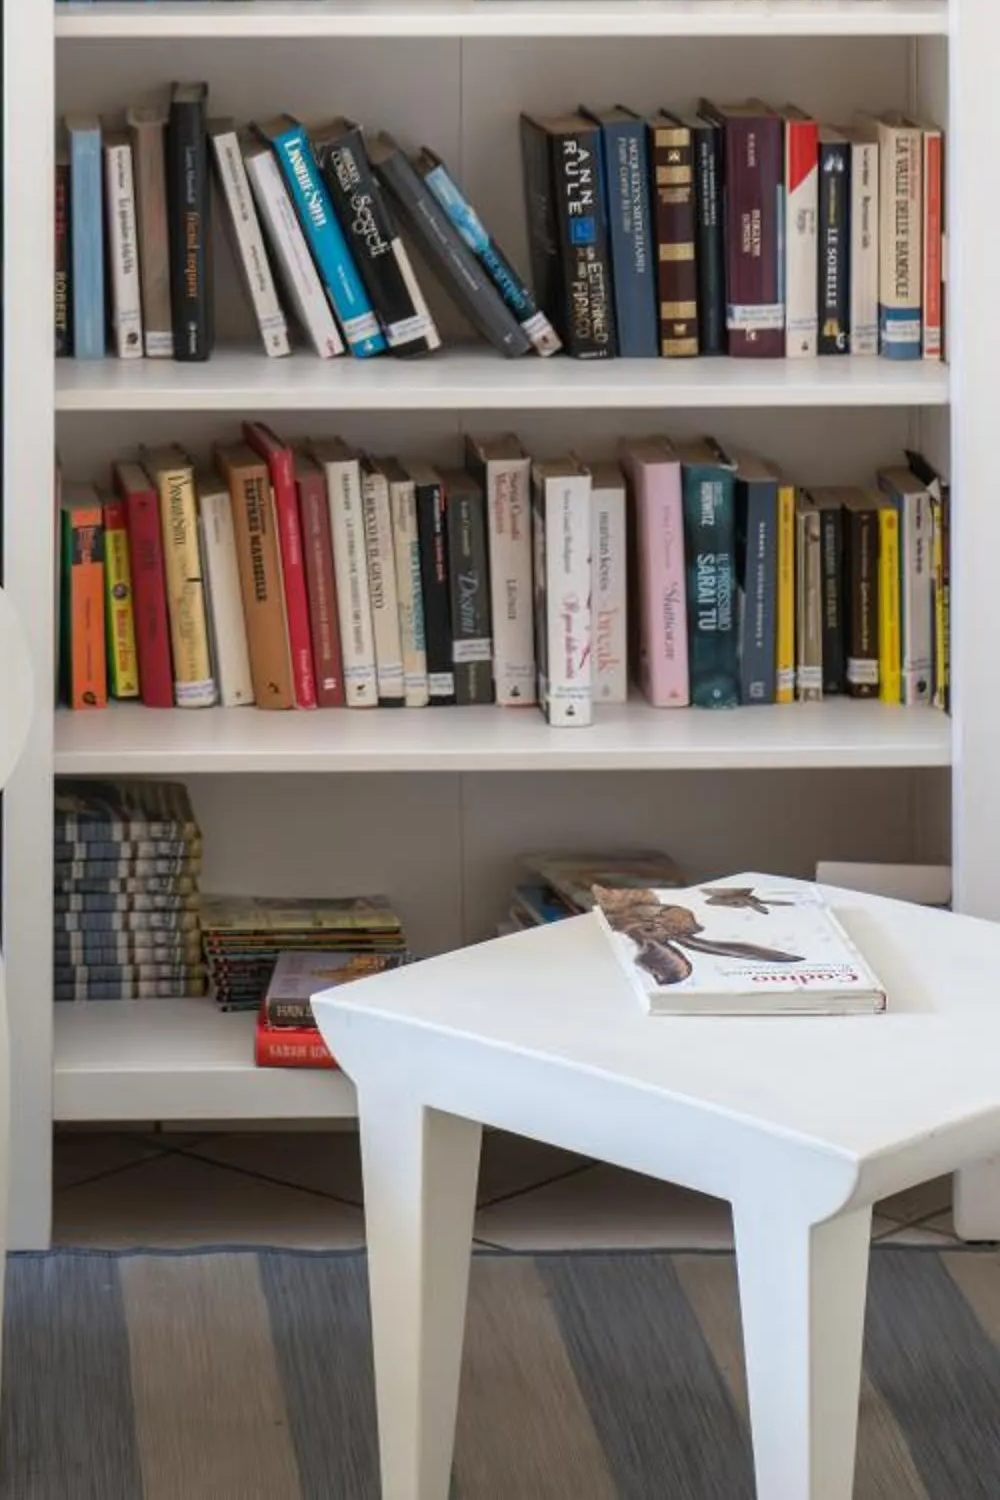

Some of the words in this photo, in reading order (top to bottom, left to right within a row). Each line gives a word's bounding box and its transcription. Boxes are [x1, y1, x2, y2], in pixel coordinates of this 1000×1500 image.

[894, 136, 909, 154] LA
[562, 140, 583, 216] RULE
[577, 147, 594, 206] ANN
[894, 157, 909, 195] VALLE
[187, 211, 201, 249] friend
[825, 227, 838, 244] LE
[894, 199, 909, 237] DELLE
[185, 251, 199, 298] request
[825, 247, 838, 308] SORELLE
[894, 240, 909, 299] BAMBOLE
[570, 281, 591, 339] FIANCO
[587, 262, 609, 343] ESTRANEO
[598, 510, 611, 554] marian
[696, 553, 716, 604] SARAI
[718, 553, 732, 564] IL
[697, 607, 717, 631] TU
[717, 566, 733, 631] PROSSIMO
[597, 607, 621, 673] break
